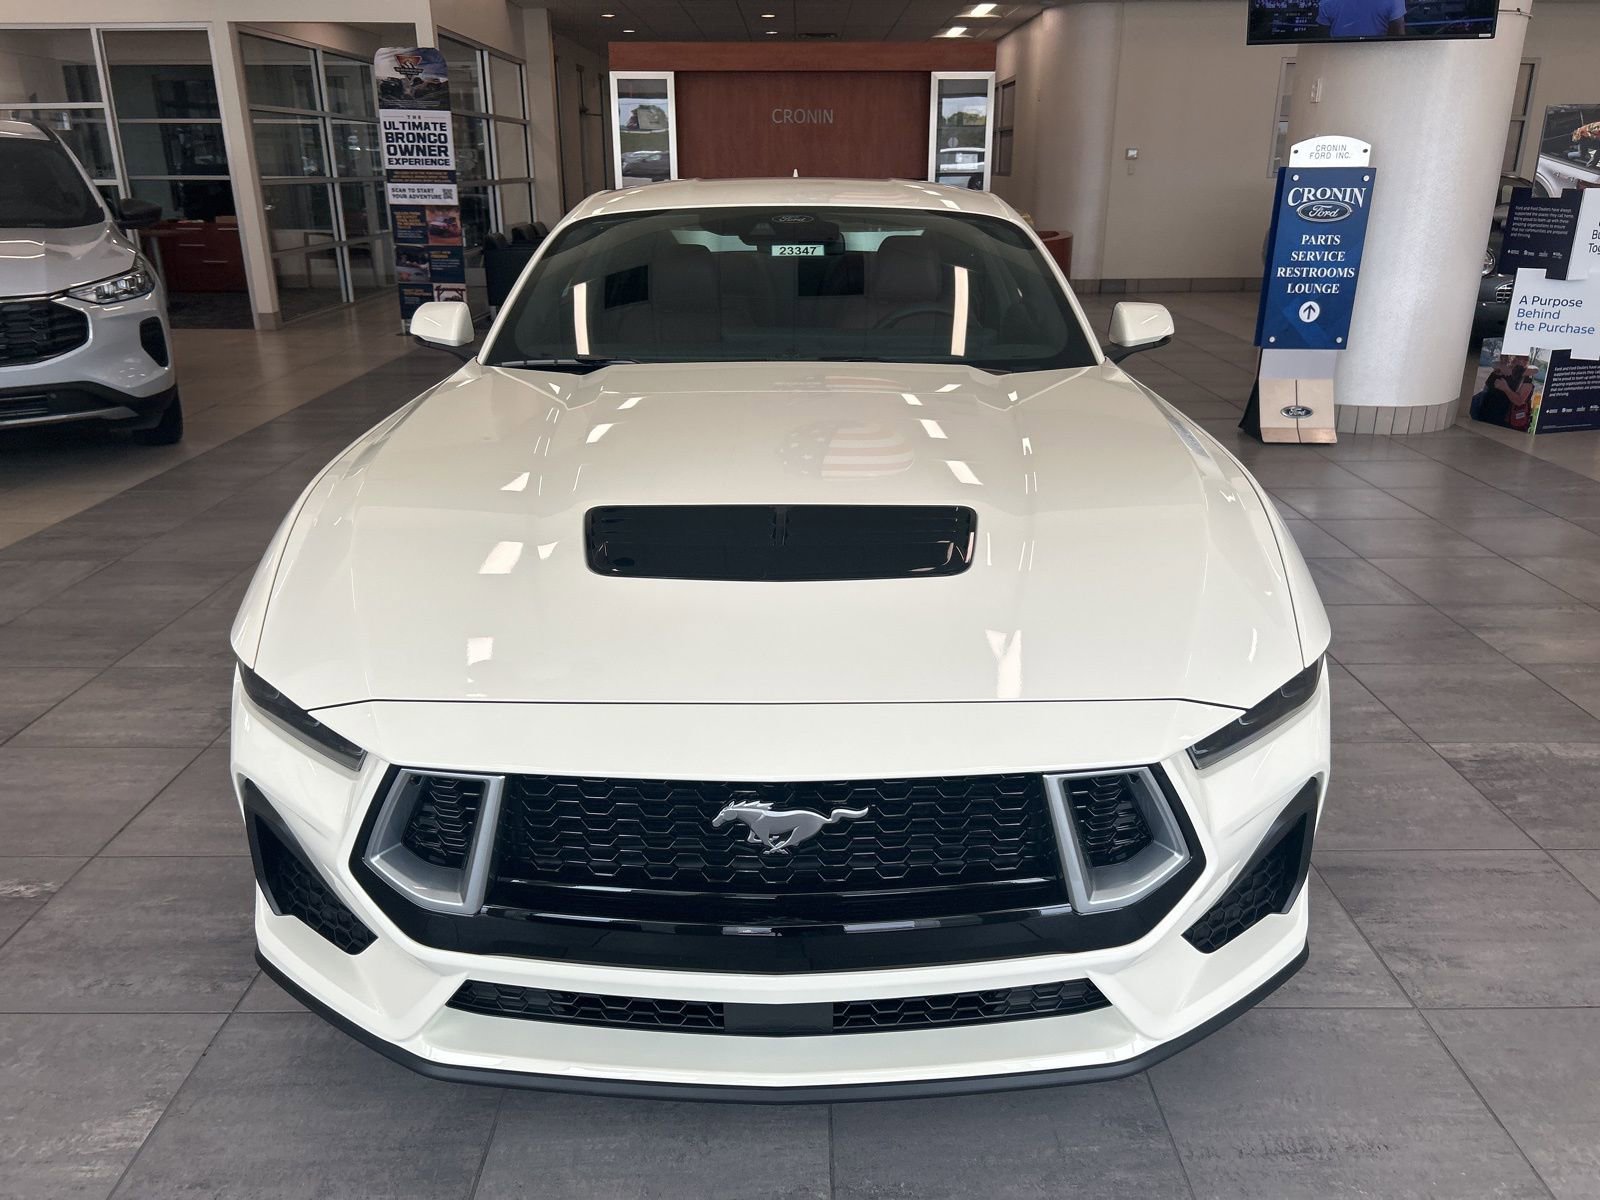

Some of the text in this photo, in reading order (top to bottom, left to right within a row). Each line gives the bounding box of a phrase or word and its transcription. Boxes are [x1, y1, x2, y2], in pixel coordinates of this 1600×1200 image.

[772, 108, 834, 124] CRONIN
[383, 121, 447, 131] ULTIMATE
[385, 132, 448, 144] BRONCO
[386, 144, 449, 157] OWNER
[1315, 144, 1347, 152] CRONIN
[1309, 152, 1351, 160] FORD INC.
[388, 158, 450, 166] EXPERIENCE
[1287, 187, 1366, 208] CRONIN
[1308, 204, 1339, 218] Ford
[1301, 234, 1341, 246] PARTS
[779, 246, 817, 255] 23347
[1290, 251, 1346, 262] SERVICE
[1276, 267, 1355, 278] RESTROOMS
[1286, 283, 1340, 294] LOUNGE
[1519, 295, 1583, 307] A Purpose
[1517, 308, 1561, 319] Behind
[1514, 321, 1595, 334] the Purchase
